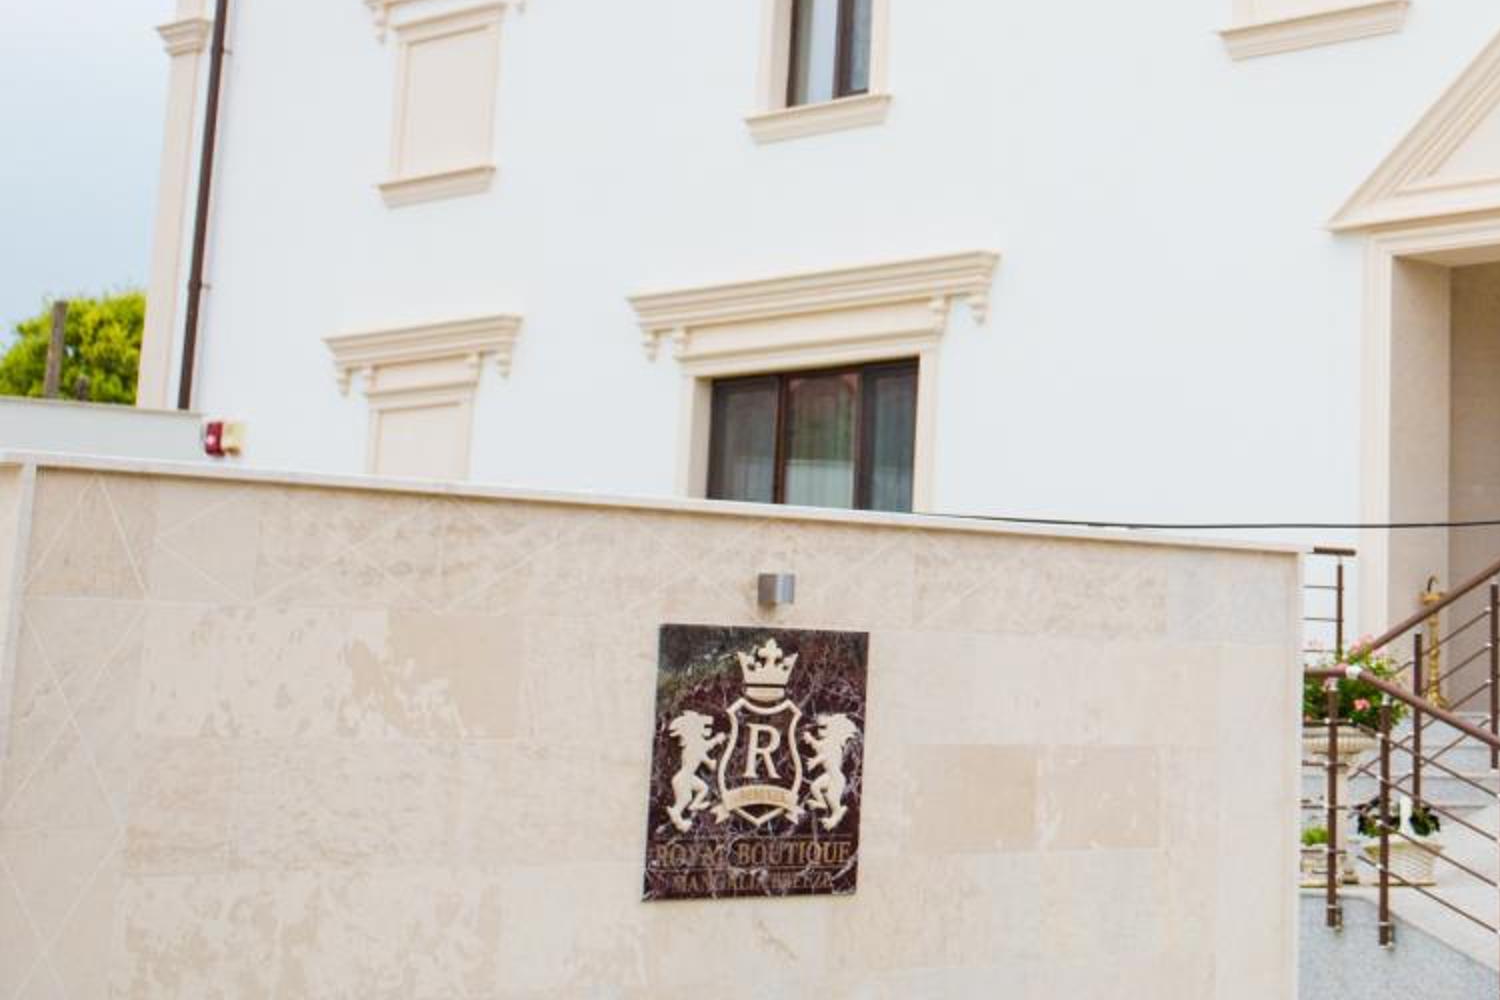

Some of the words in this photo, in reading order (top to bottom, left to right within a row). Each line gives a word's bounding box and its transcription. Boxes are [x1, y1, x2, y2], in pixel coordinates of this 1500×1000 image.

[741, 723, 782, 779] R
[655, 842, 727, 867] ROYAL
[736, 841, 851, 866] BOUTIQUE
